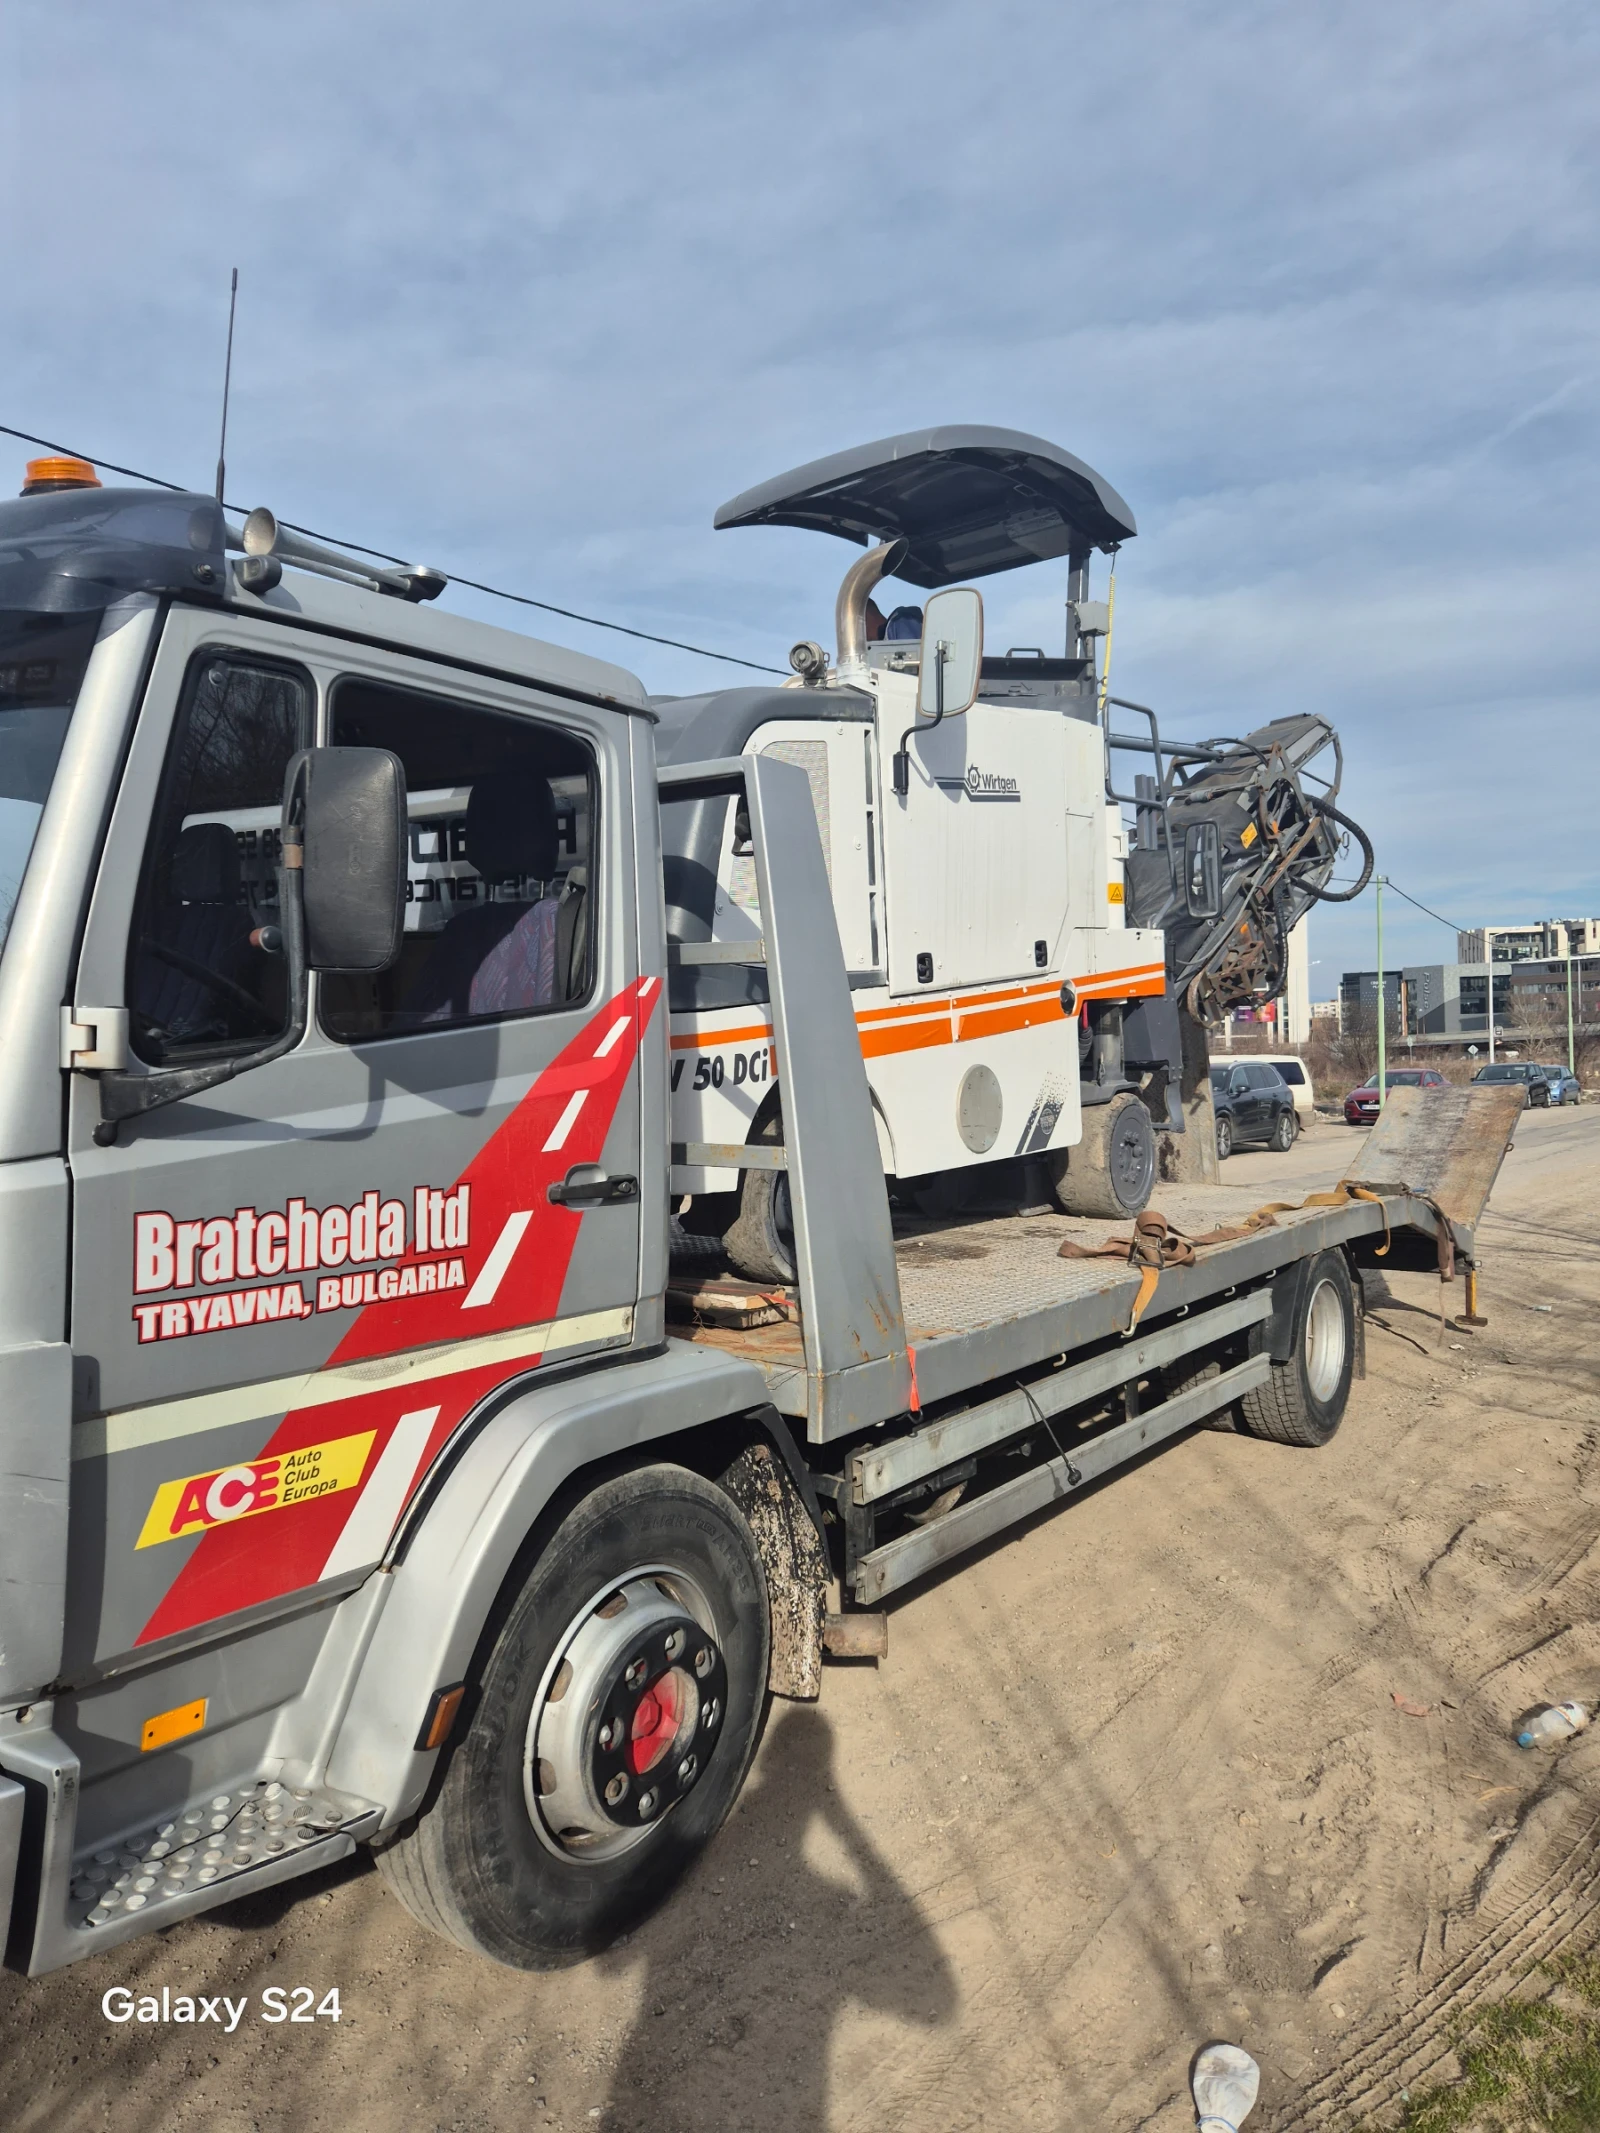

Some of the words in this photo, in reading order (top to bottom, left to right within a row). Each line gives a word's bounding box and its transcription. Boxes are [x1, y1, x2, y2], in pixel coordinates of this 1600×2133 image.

[981, 773, 1017, 794] Wirtgen
[692, 1055, 725, 1092] 50
[733, 1048, 769, 1086] DCi
[133, 1188, 408, 1294] Bratcheda
[413, 1184, 472, 1255] ltd
[133, 1283, 313, 1344] TRYAVNA,
[318, 1257, 467, 1312] BULGARIA
[284, 1448, 322, 1470] Auto
[284, 1465, 320, 1487] Club
[170, 1458, 283, 1534] ACE
[281, 1477, 338, 1504] Europa
